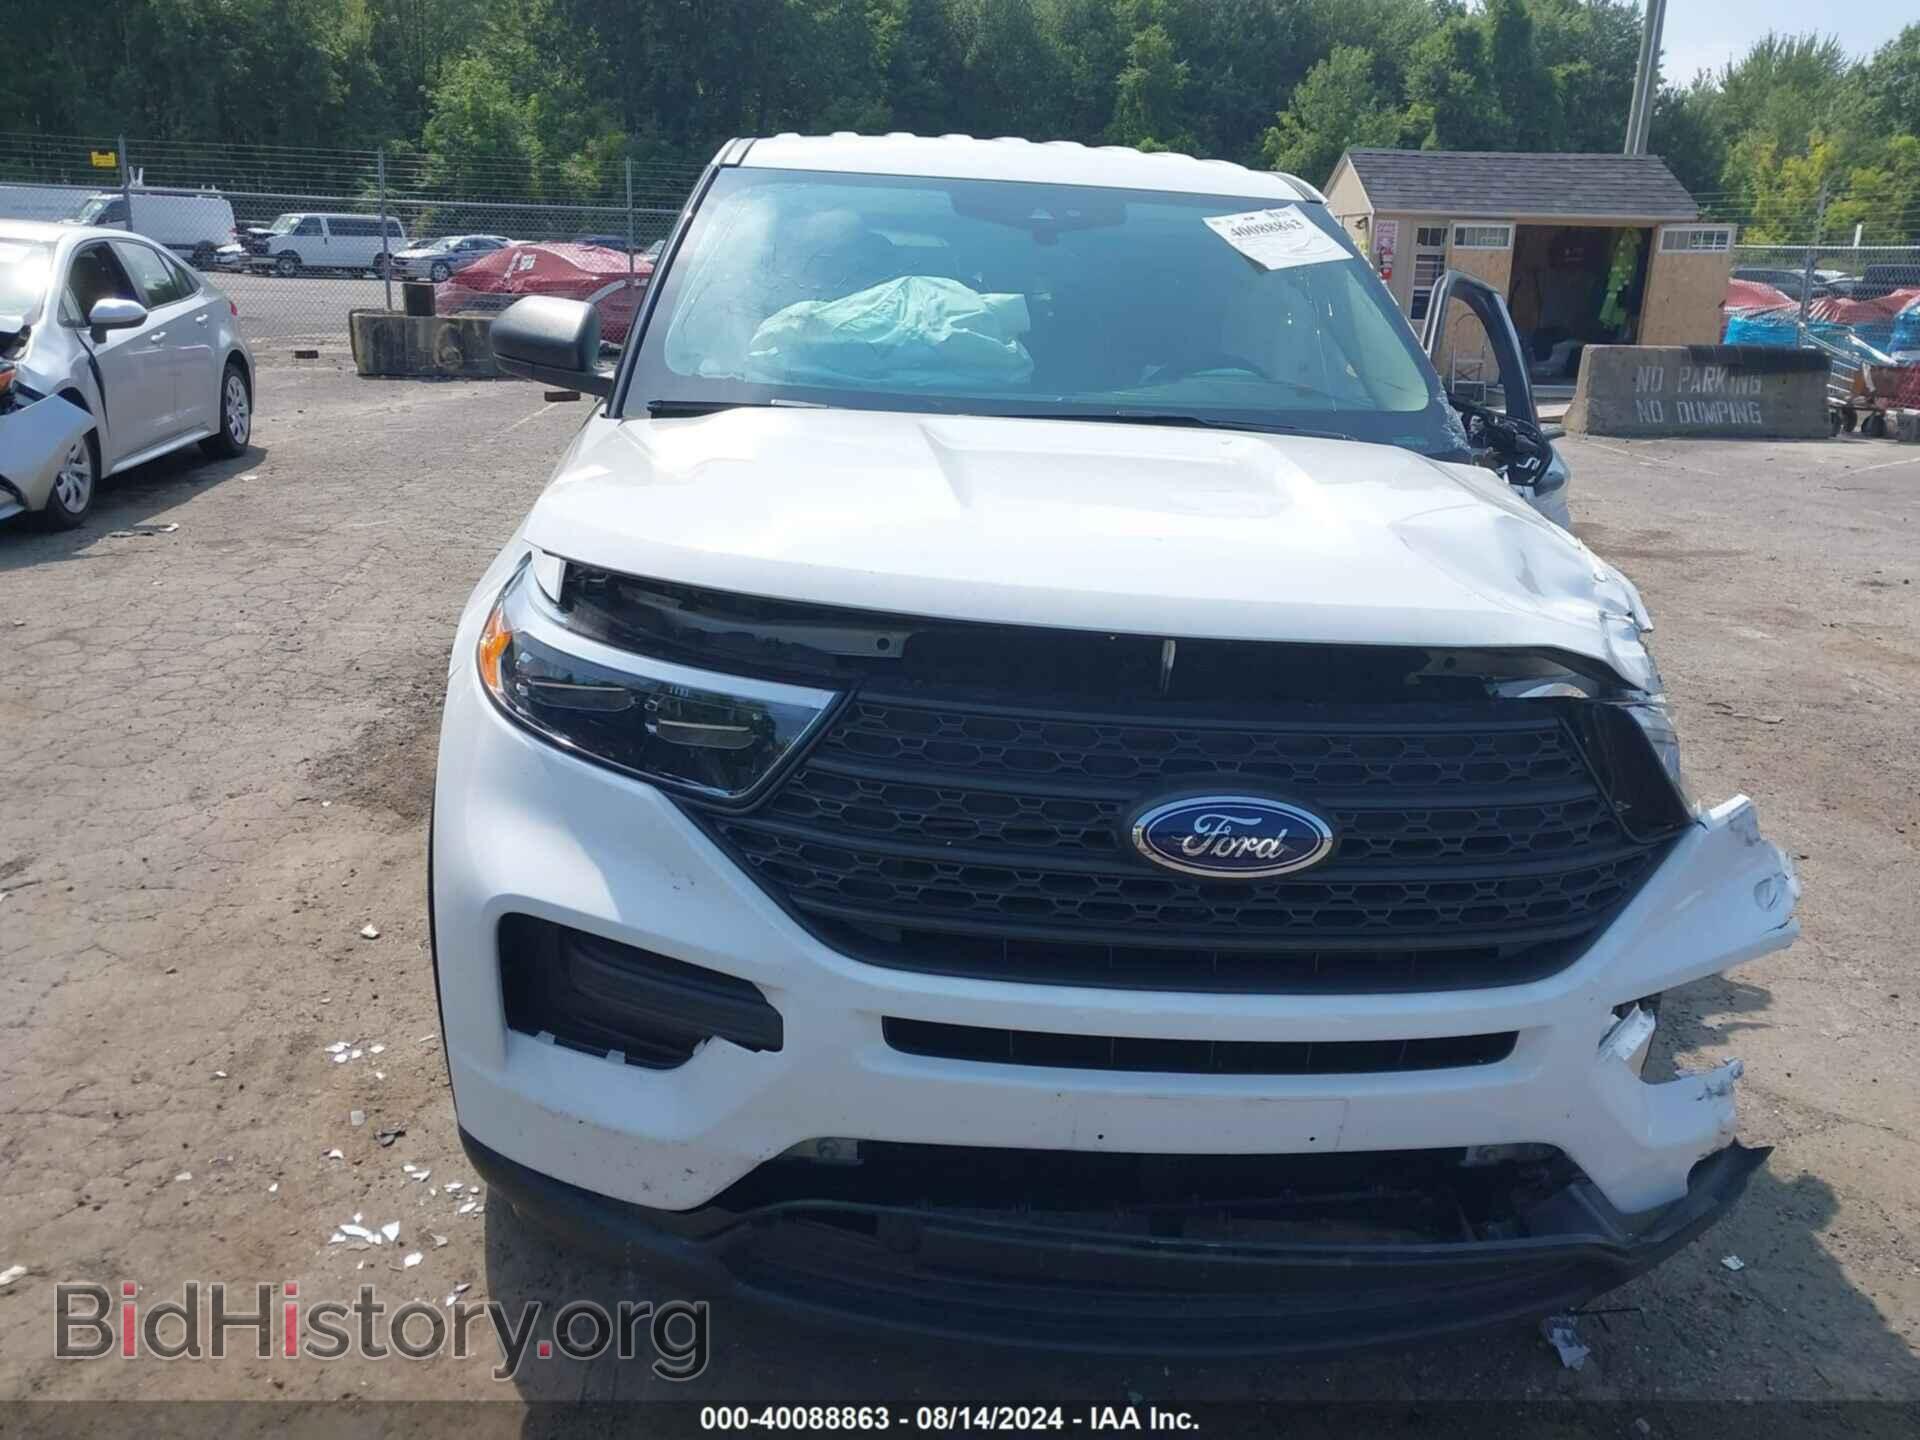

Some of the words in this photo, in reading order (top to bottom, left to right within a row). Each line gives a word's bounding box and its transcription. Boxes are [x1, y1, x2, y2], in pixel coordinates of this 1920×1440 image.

[1635, 366, 1664, 393] NO
[1677, 366, 1762, 393] PARKING
[1635, 400, 1664, 425] NO
[1677, 401, 1762, 425] DUMPING
[1179, 813, 1290, 859] Ford
